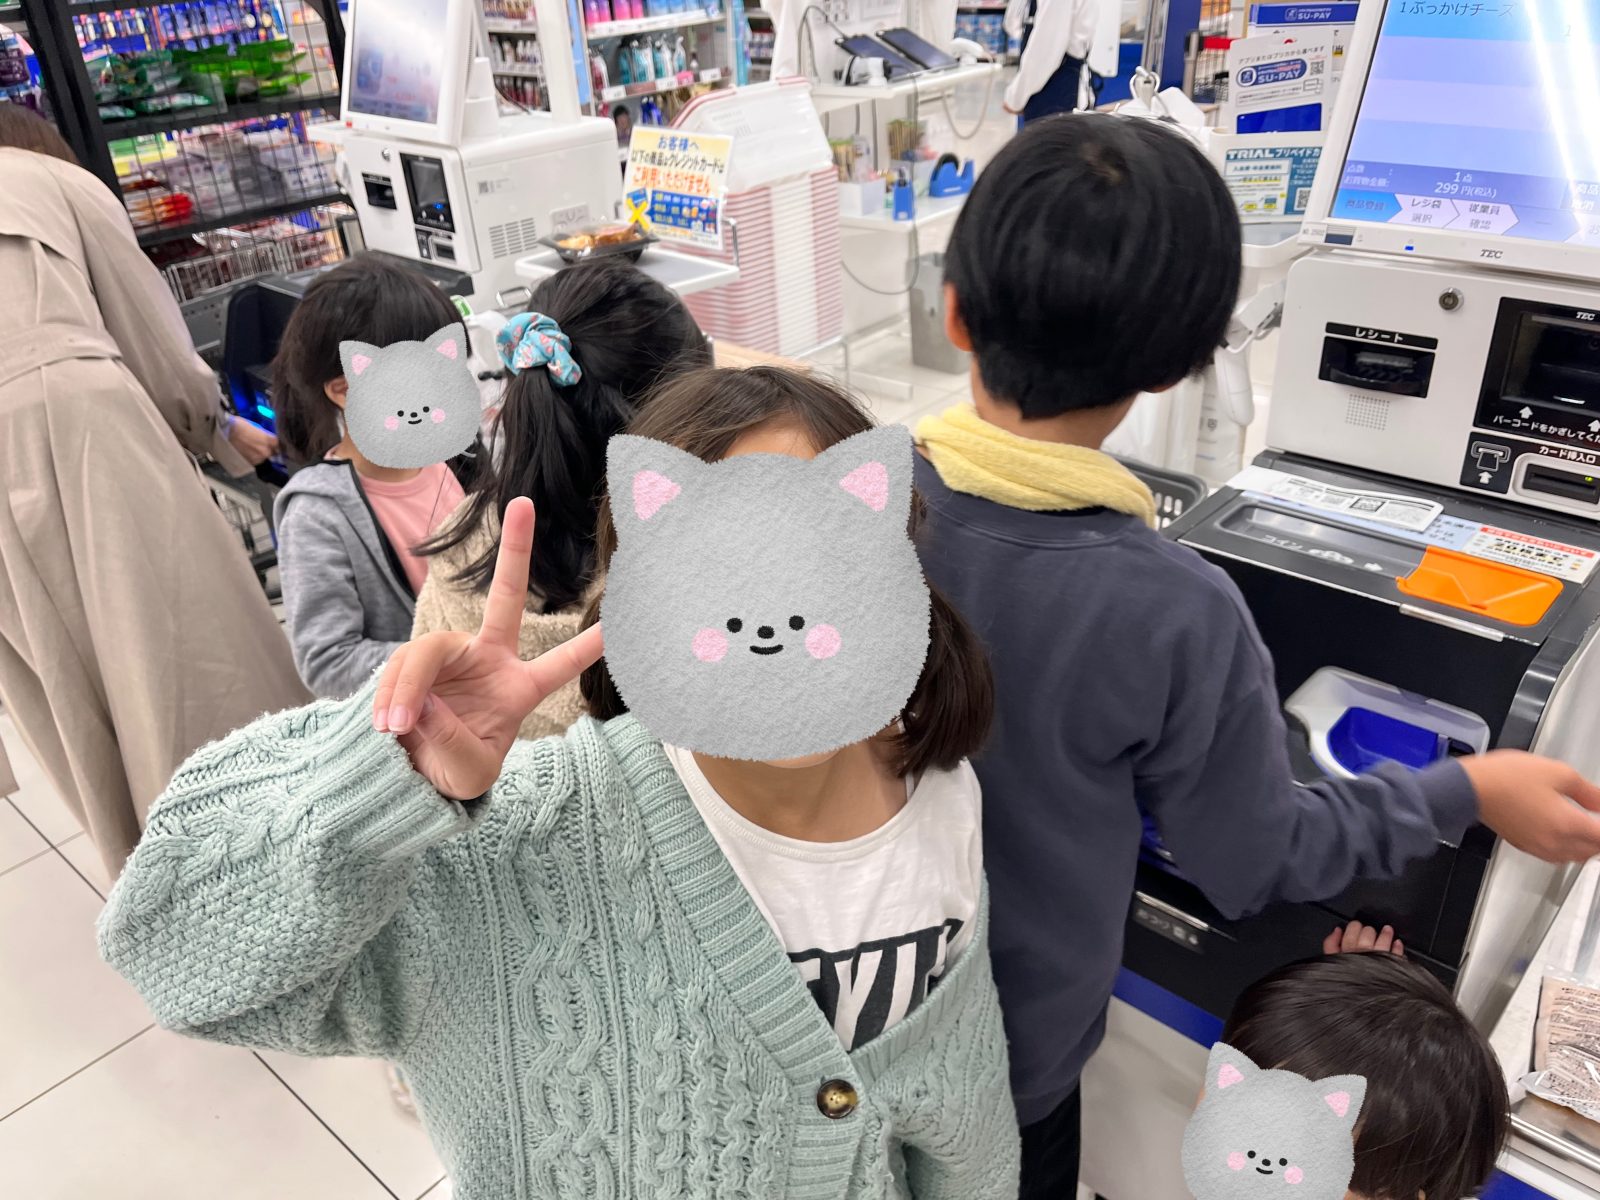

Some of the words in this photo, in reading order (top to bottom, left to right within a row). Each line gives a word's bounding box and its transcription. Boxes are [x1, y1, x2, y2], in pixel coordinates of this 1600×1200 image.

[657, 136, 700, 152] お客様へ
[1226, 149, 1275, 160] TRIAL
[632, 166, 712, 195] ご利用いただけません
[1410, 197, 1443, 209] レジ袋
[1468, 203, 1501, 216] 従業員
[1411, 214, 1433, 224] 選択
[1469, 219, 1492, 230] 確認
[1480, 249, 1503, 260] TEC
[1575, 311, 1596, 321] TEC
[1355, 327, 1404, 343] レシート
[1538, 445, 1597, 464] カード挿入口
